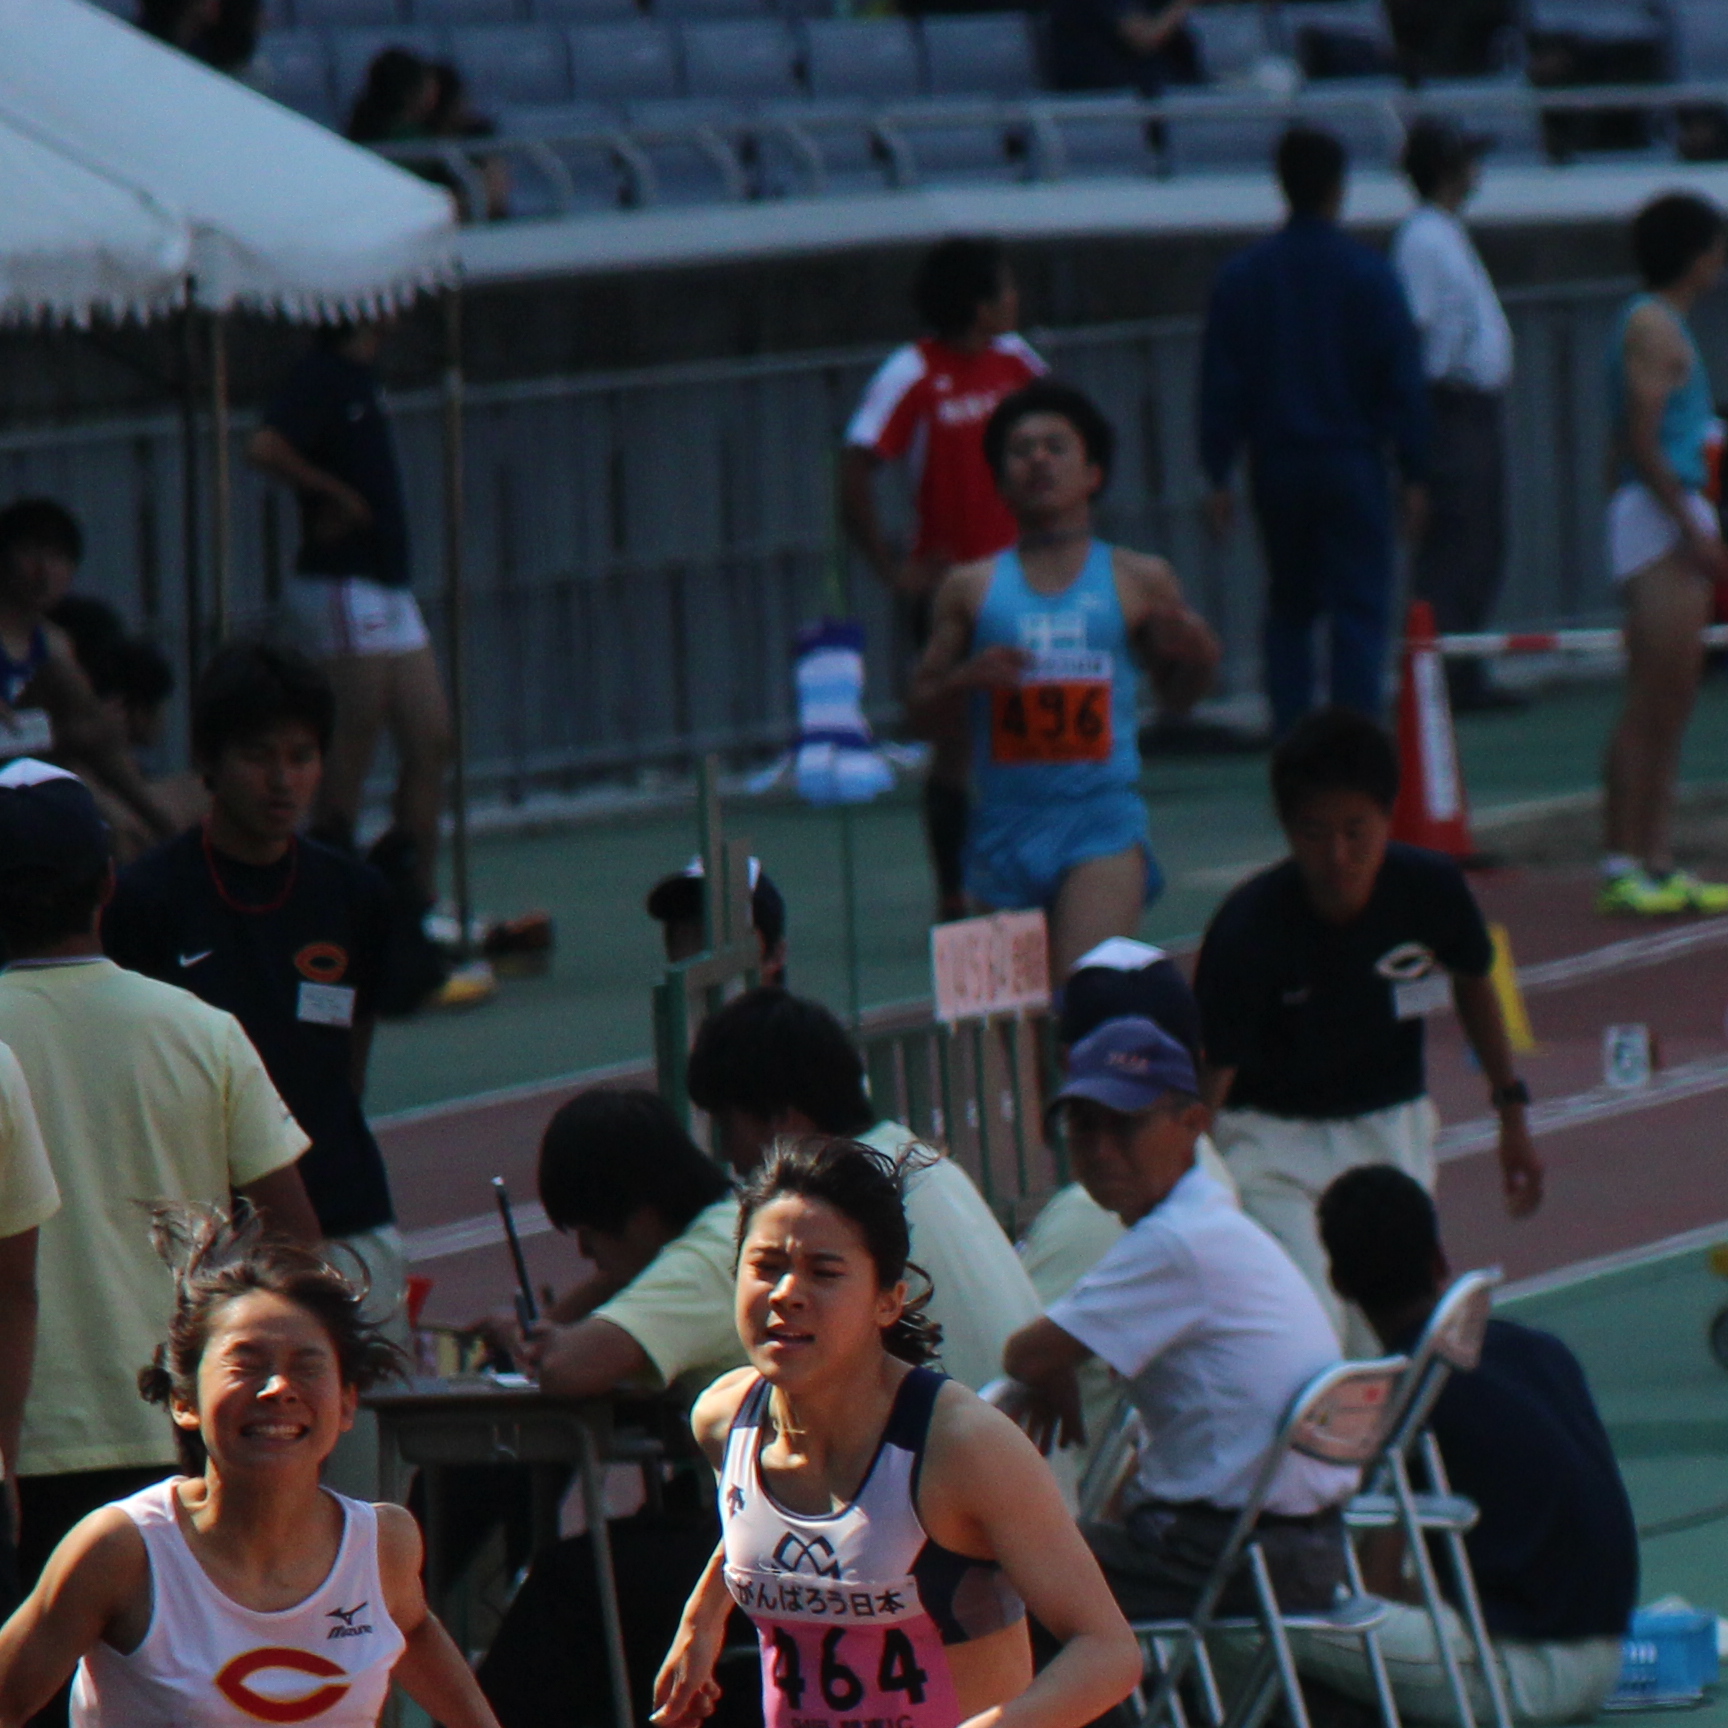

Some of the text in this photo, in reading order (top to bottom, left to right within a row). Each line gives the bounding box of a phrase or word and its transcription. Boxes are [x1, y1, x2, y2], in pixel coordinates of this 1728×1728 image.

[1003, 684, 1104, 742] 496
[736, 1580, 905, 1617] がんばろう日本
